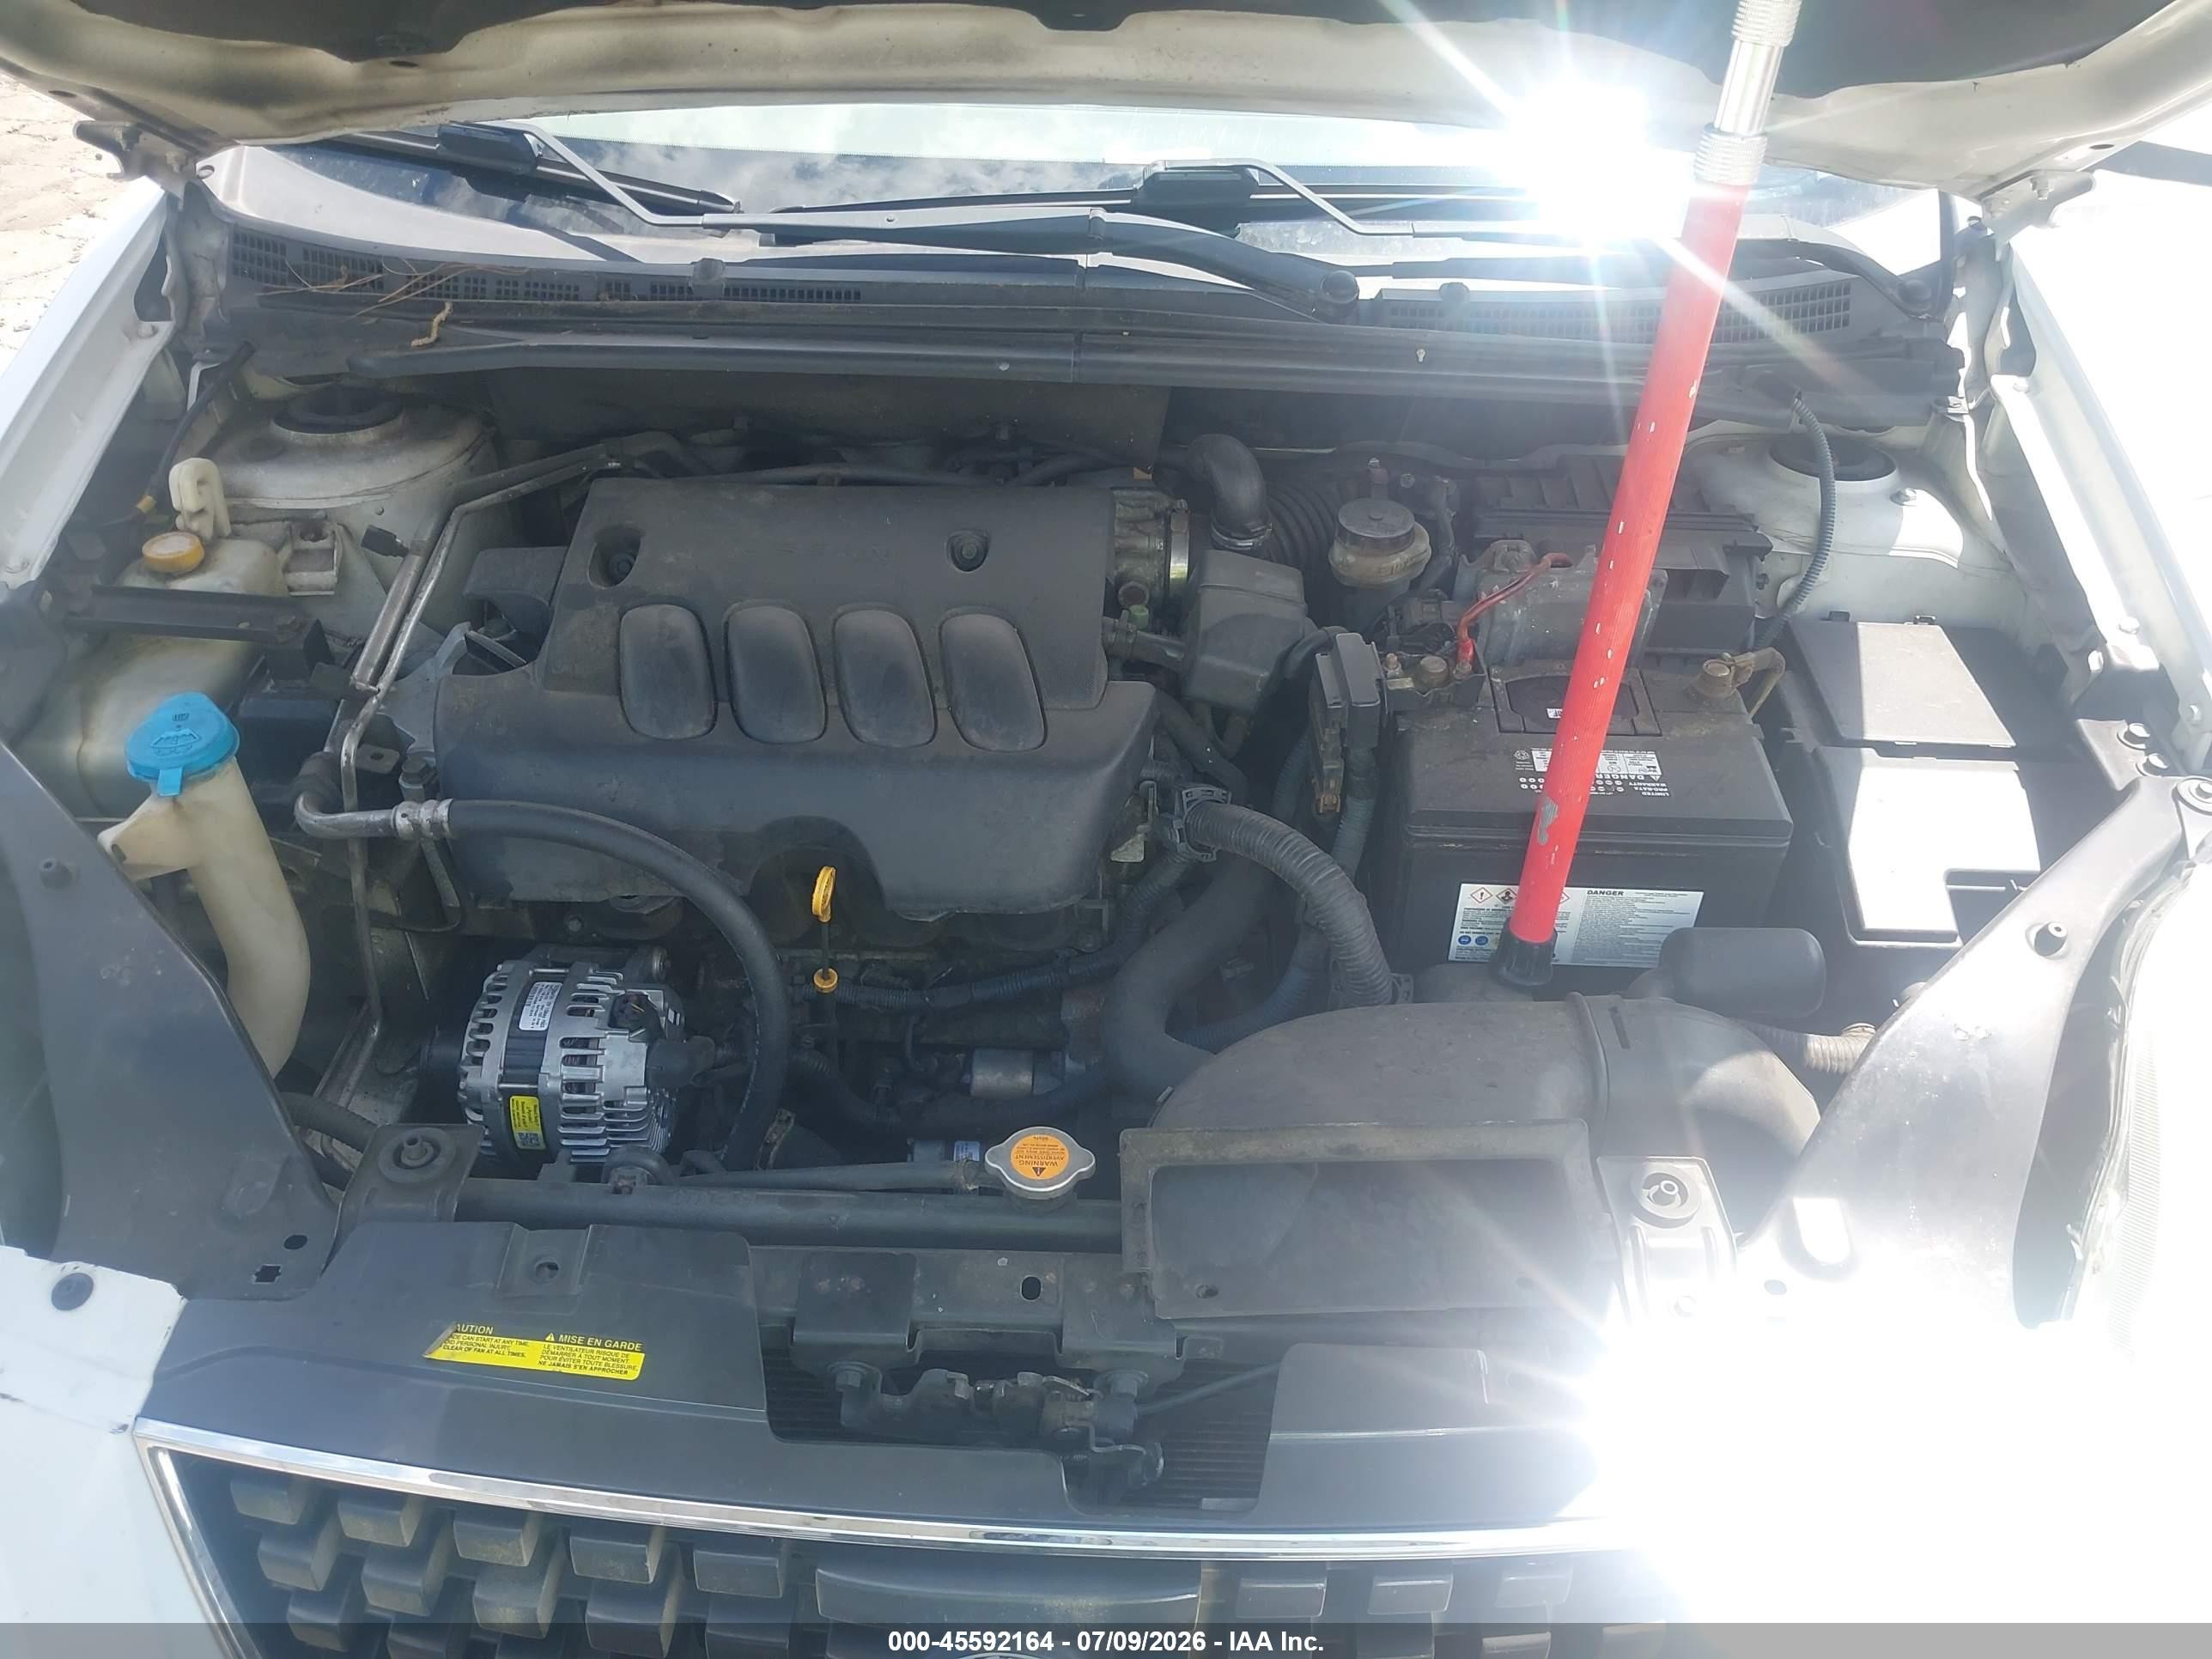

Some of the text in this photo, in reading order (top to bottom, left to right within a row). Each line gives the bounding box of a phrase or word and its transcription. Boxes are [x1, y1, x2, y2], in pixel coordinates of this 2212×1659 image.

[457, 1323, 494, 1334] AUTION
[559, 1334, 643, 1352] MISE EN GARDE
[542, 1349, 578, 1358] DÉMARRER
[552, 1345, 595, 1354] VENTILATEUR
[596, 1349, 620, 1358] RISQUE
[558, 1356, 582, 1364] ÉVITER
